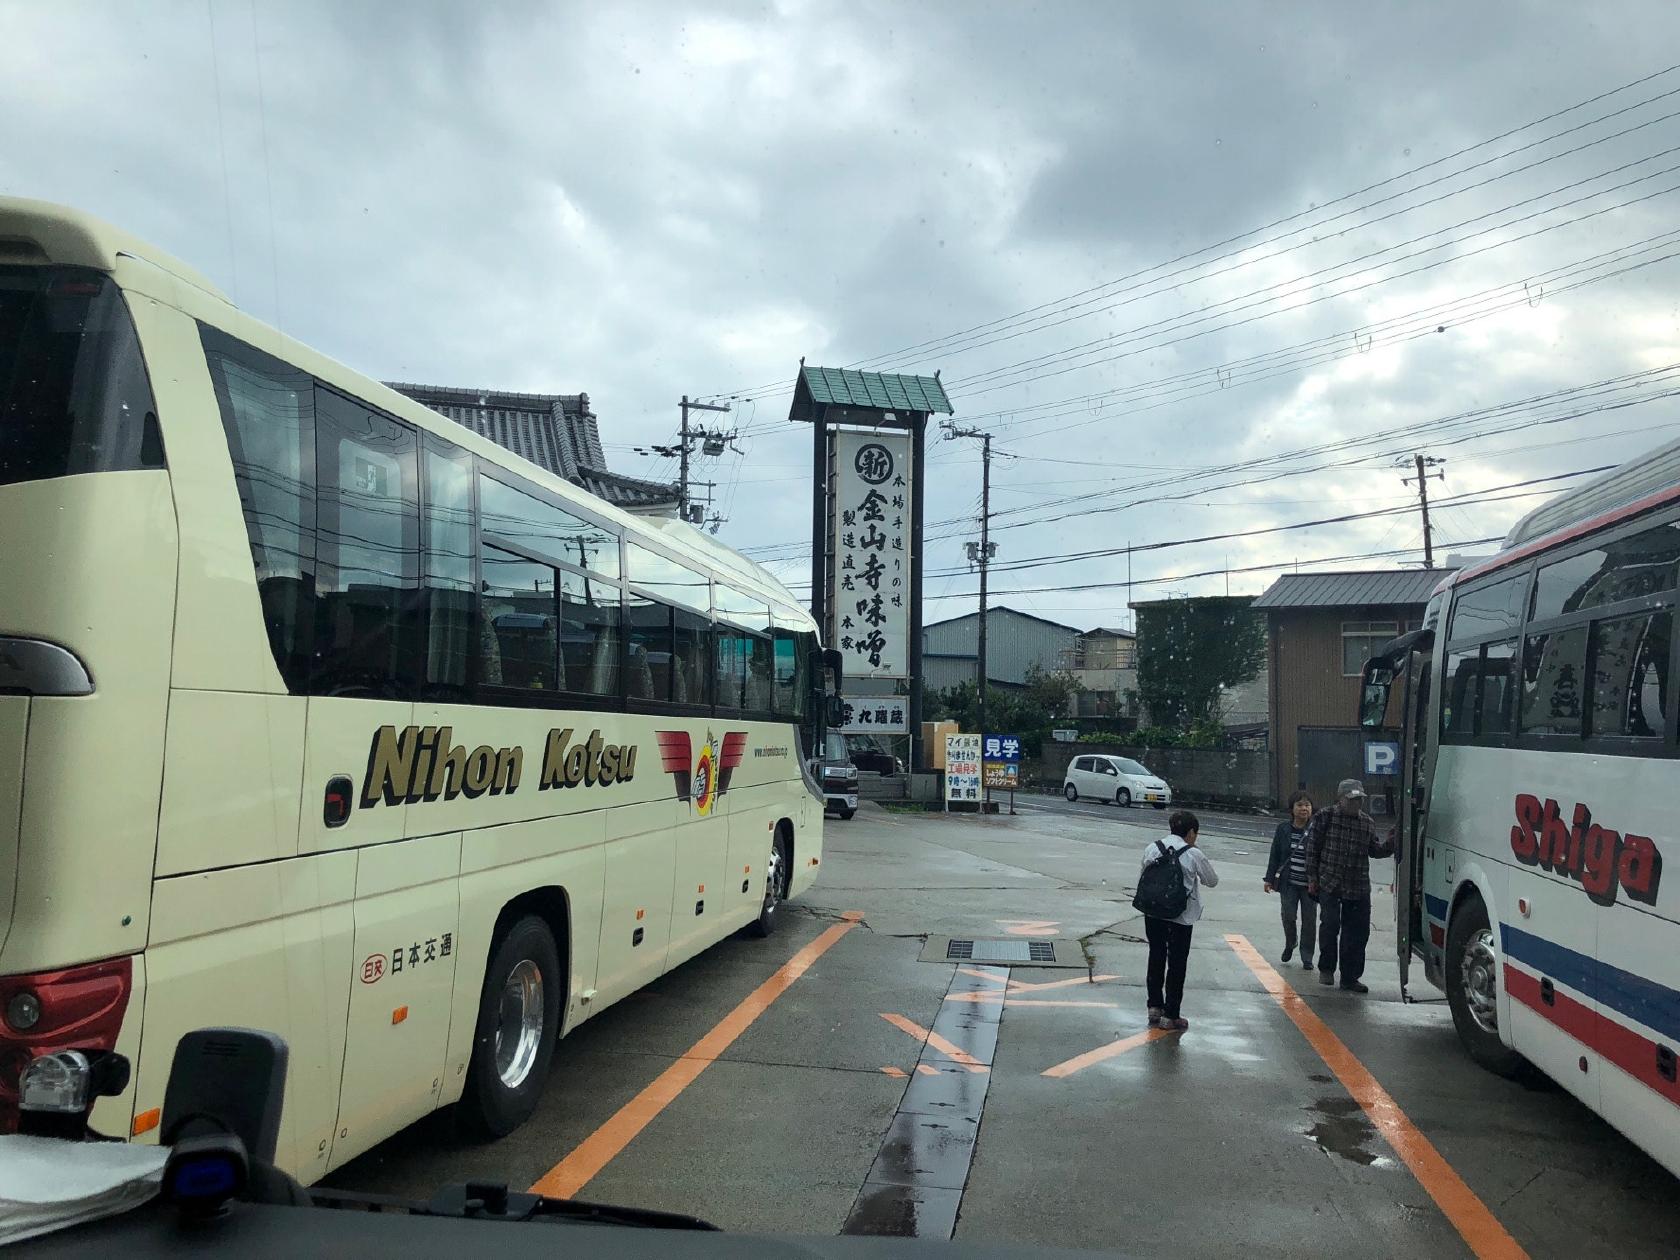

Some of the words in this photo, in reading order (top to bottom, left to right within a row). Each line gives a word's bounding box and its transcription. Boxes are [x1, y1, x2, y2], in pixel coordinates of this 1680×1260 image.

[841, 510, 856, 591] 製造直売
[891, 474, 906, 608] 本場手造りの味
[855, 489, 888, 667] 金山寺味噌
[841, 616, 855, 650] 本家
[359, 725, 524, 809] Nihon
[538, 728, 638, 791] Kotsu
[948, 763, 977, 775] 工場見学
[985, 738, 1019, 758] 見学
[1368, 746, 1394, 771] P
[951, 788, 977, 799] 無料
[1511, 793, 1663, 907] Shiga
[391, 932, 452, 975] 日本交通
